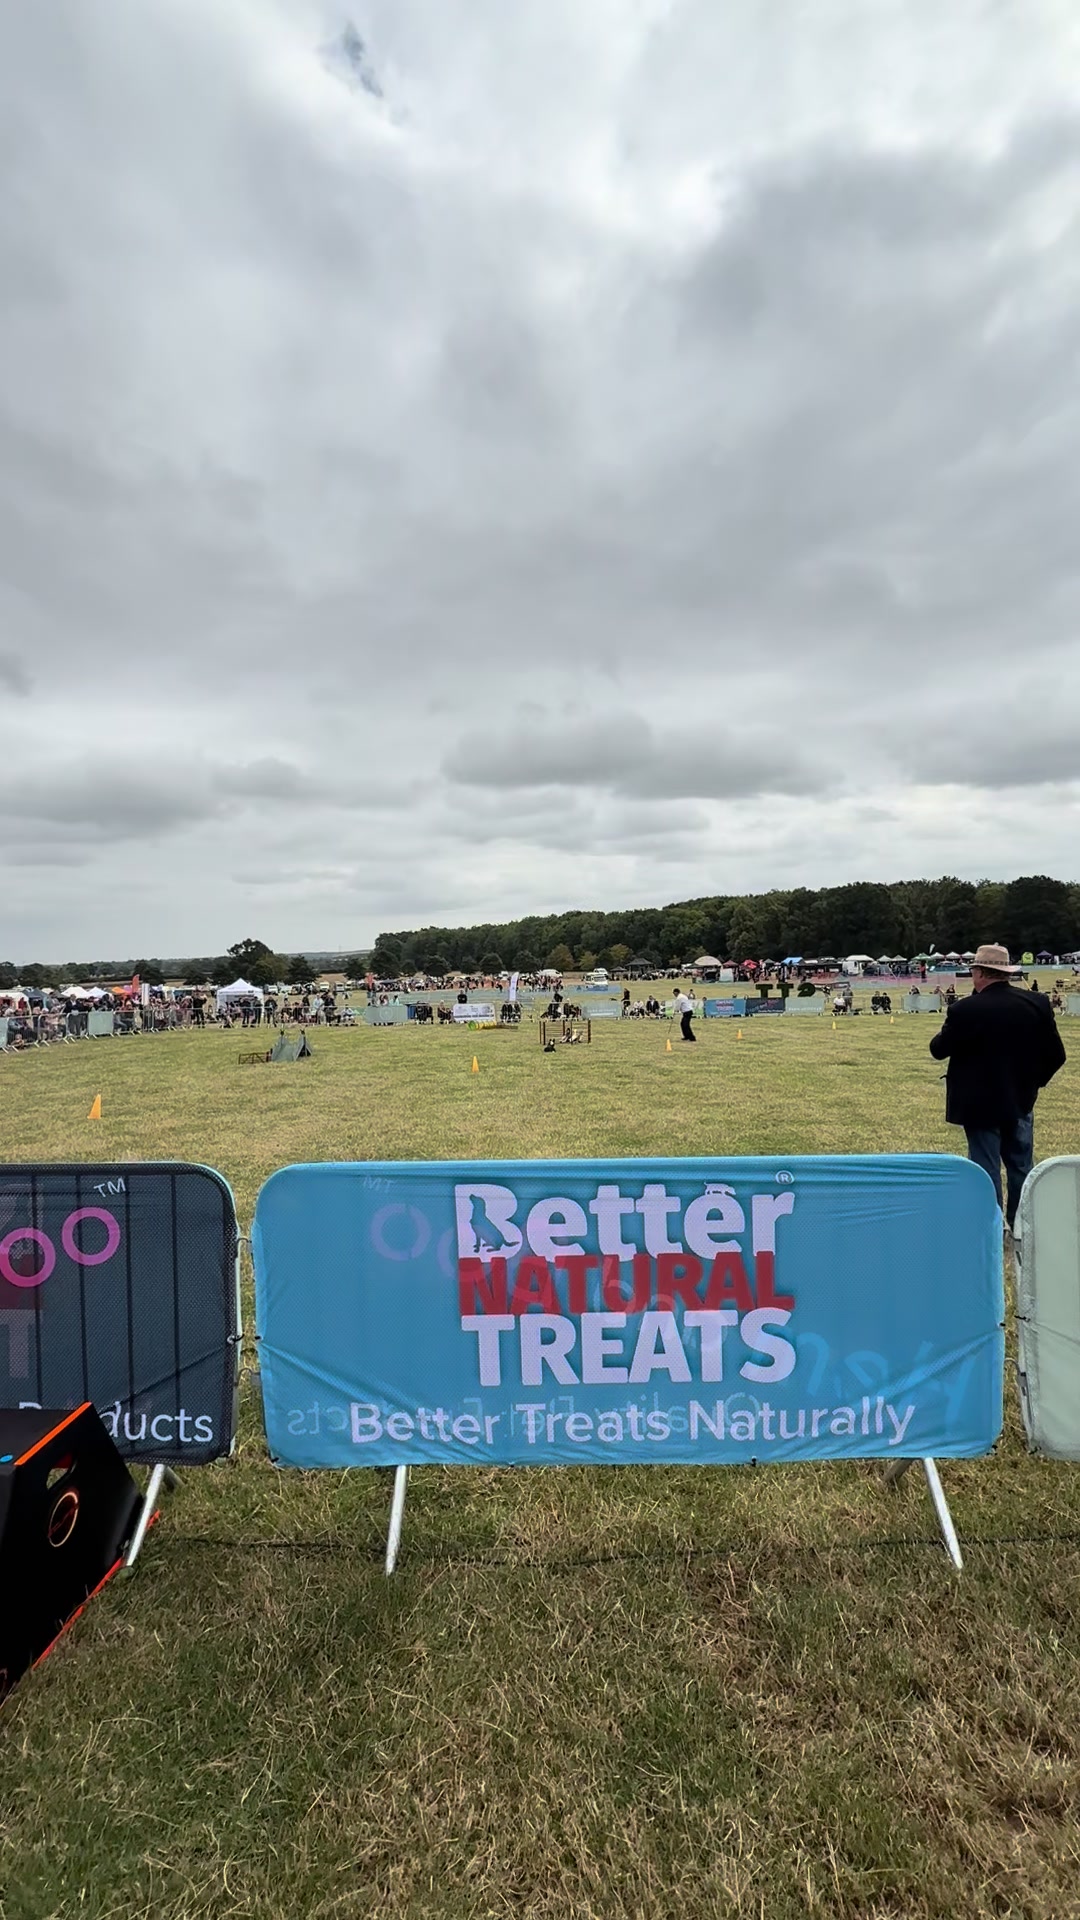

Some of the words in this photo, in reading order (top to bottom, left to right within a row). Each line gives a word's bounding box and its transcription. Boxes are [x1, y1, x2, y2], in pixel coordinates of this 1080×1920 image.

[93, 1178, 126, 1198] TM
[455, 1182, 796, 1263] Better
[458, 1251, 796, 1317] NATURAL
[461, 1307, 796, 1386] TREATS
[350, 1402, 500, 1444] Better
[515, 1403, 671, 1444] Treats
[689, 1396, 916, 1445] Naturally
